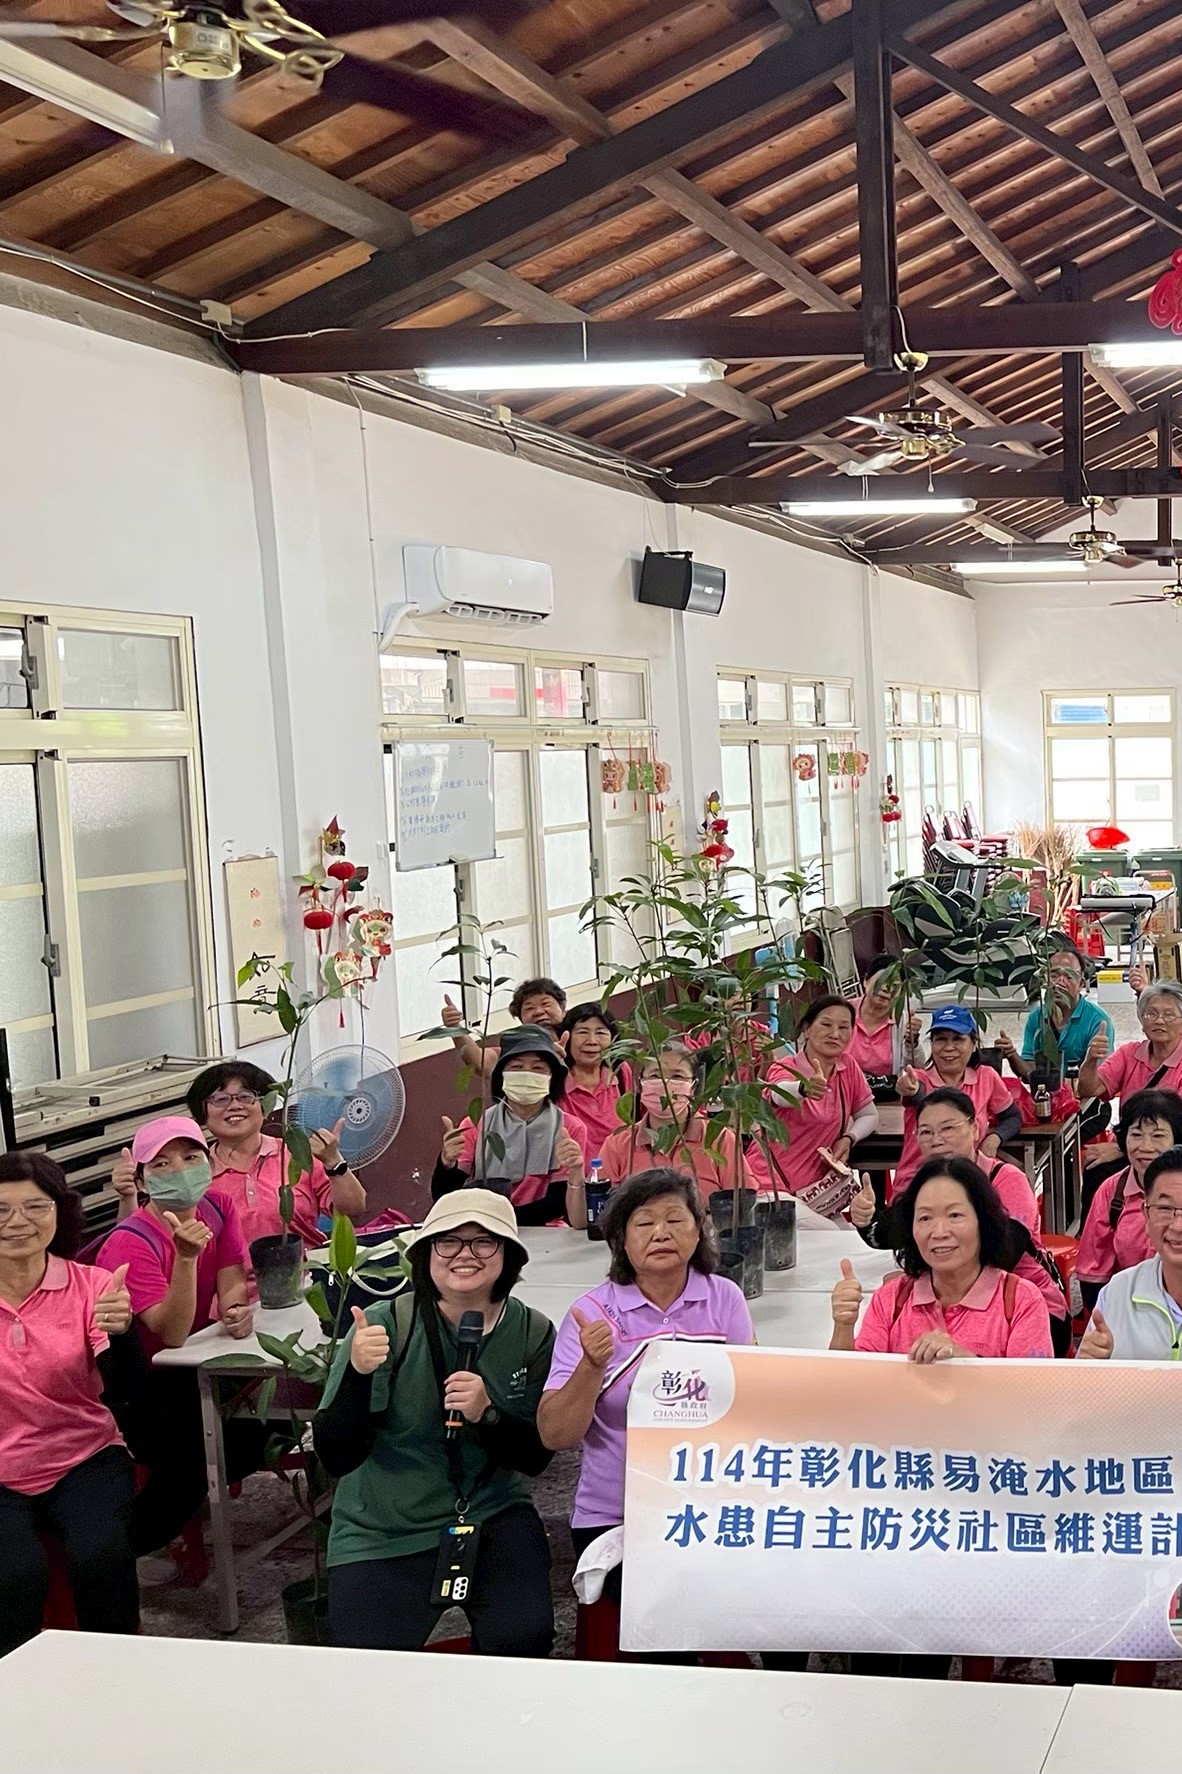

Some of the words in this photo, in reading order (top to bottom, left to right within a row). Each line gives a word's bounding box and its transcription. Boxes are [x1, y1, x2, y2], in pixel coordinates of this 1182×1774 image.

[661, 1369, 708, 1402] 彰化
[653, 1411, 709, 1419] CHANGHUA
[672, 1445, 1174, 1498] 114年彰化縣易淹水地區
